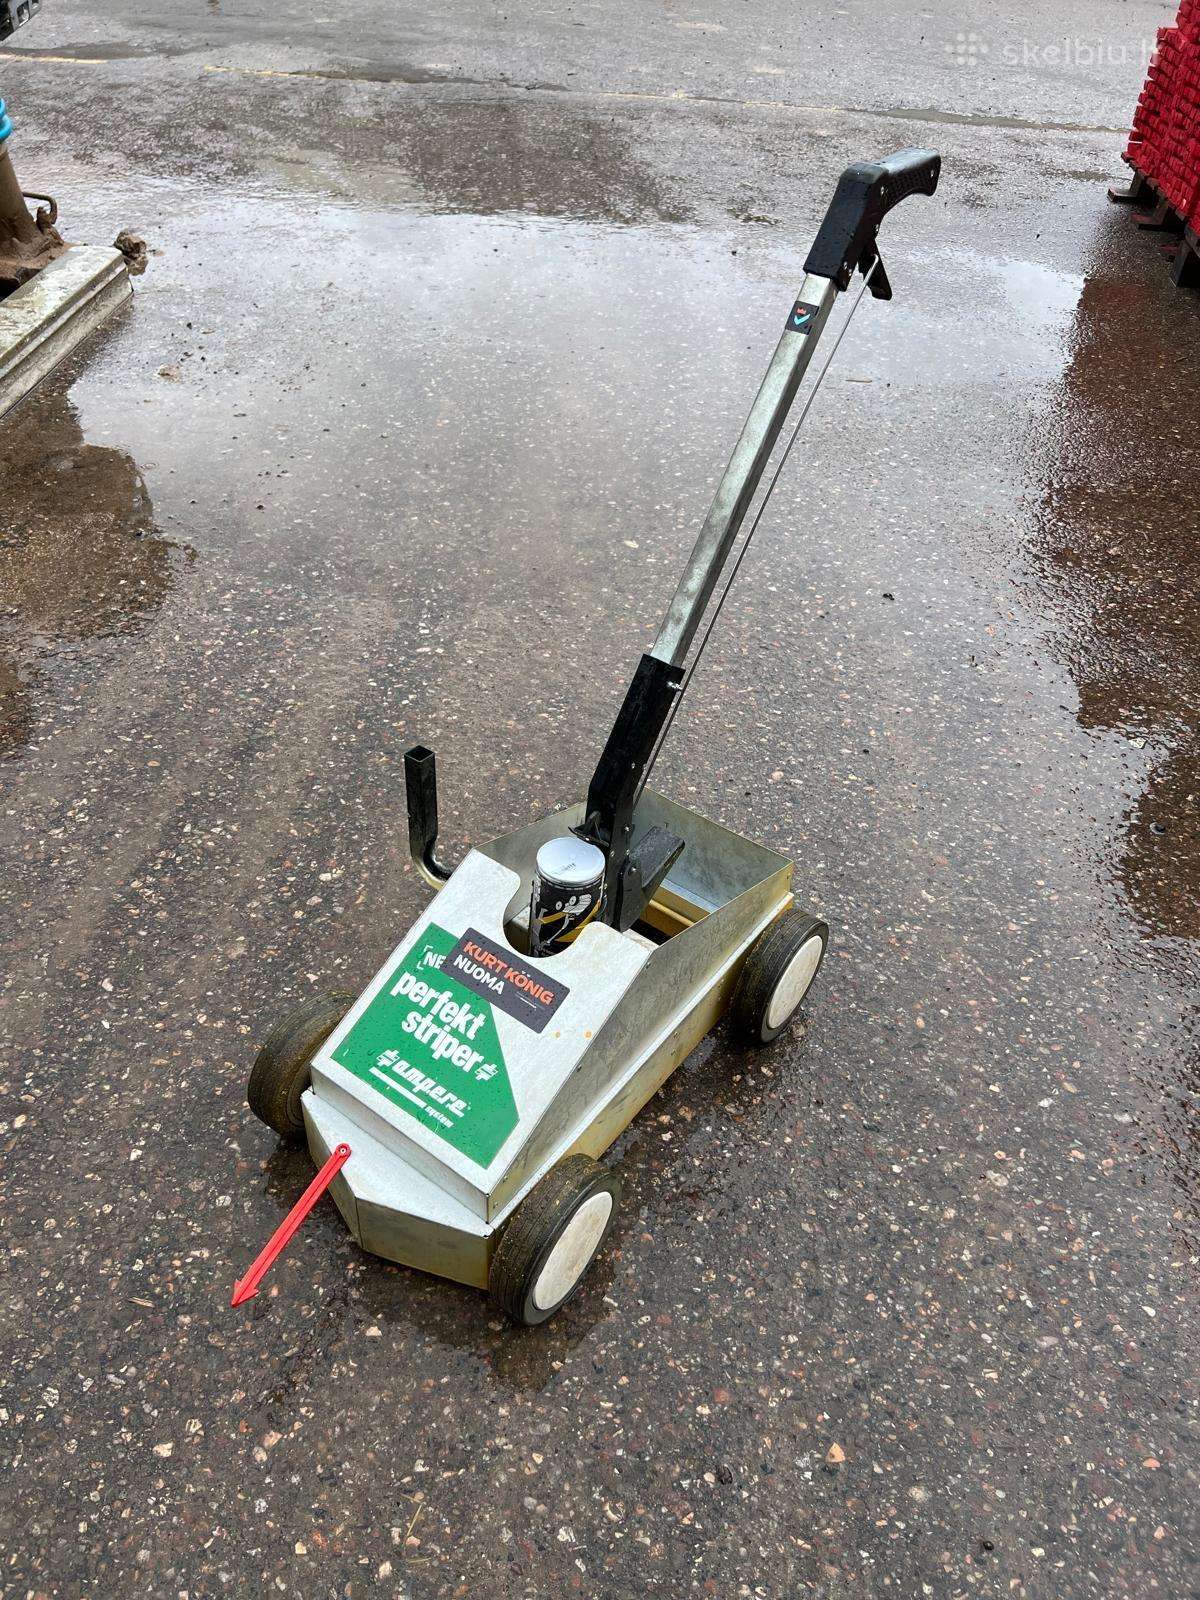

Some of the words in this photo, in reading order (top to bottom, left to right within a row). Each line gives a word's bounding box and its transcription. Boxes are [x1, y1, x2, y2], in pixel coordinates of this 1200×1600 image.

[390, 971, 486, 1040] perfekt
[453, 954, 505, 995] NUOMA
[462, 941, 508, 973] KURT
[504, 970, 556, 1006] KÖNIG
[401, 1010, 485, 1073] striper
